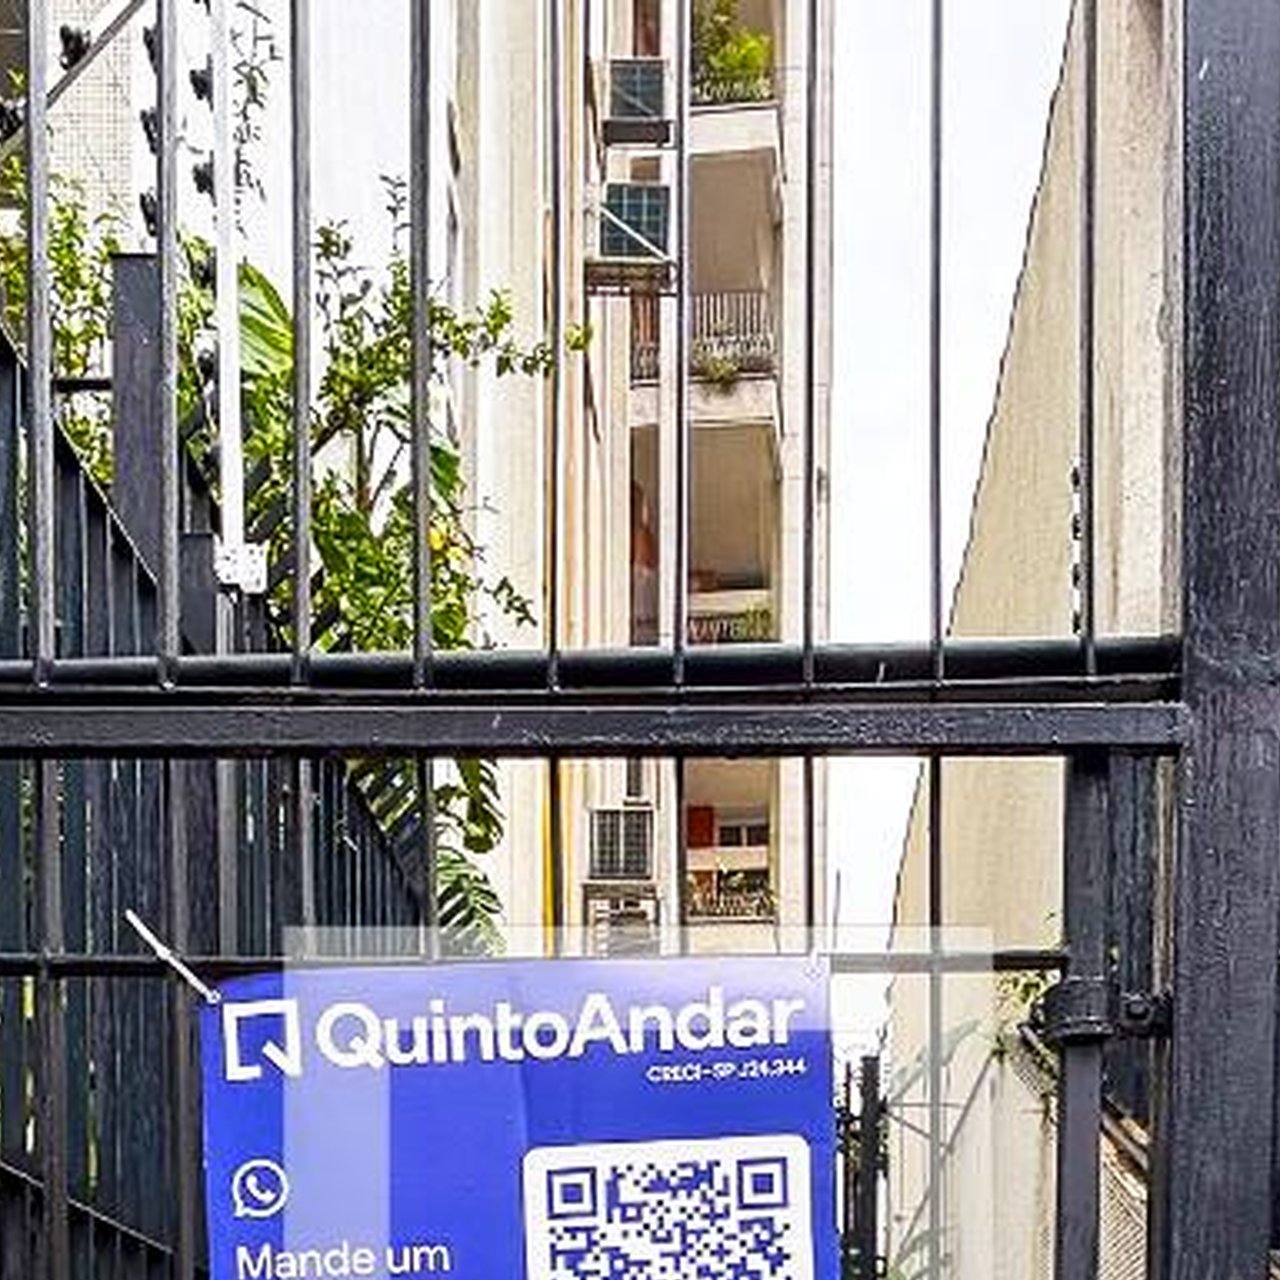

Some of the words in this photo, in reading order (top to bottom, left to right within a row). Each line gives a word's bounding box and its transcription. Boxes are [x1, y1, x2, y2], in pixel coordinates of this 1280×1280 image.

[315, 986, 805, 1067] QuintoAndar
[236, 1241, 375, 1280] Mande
[386, 1244, 450, 1273] um
